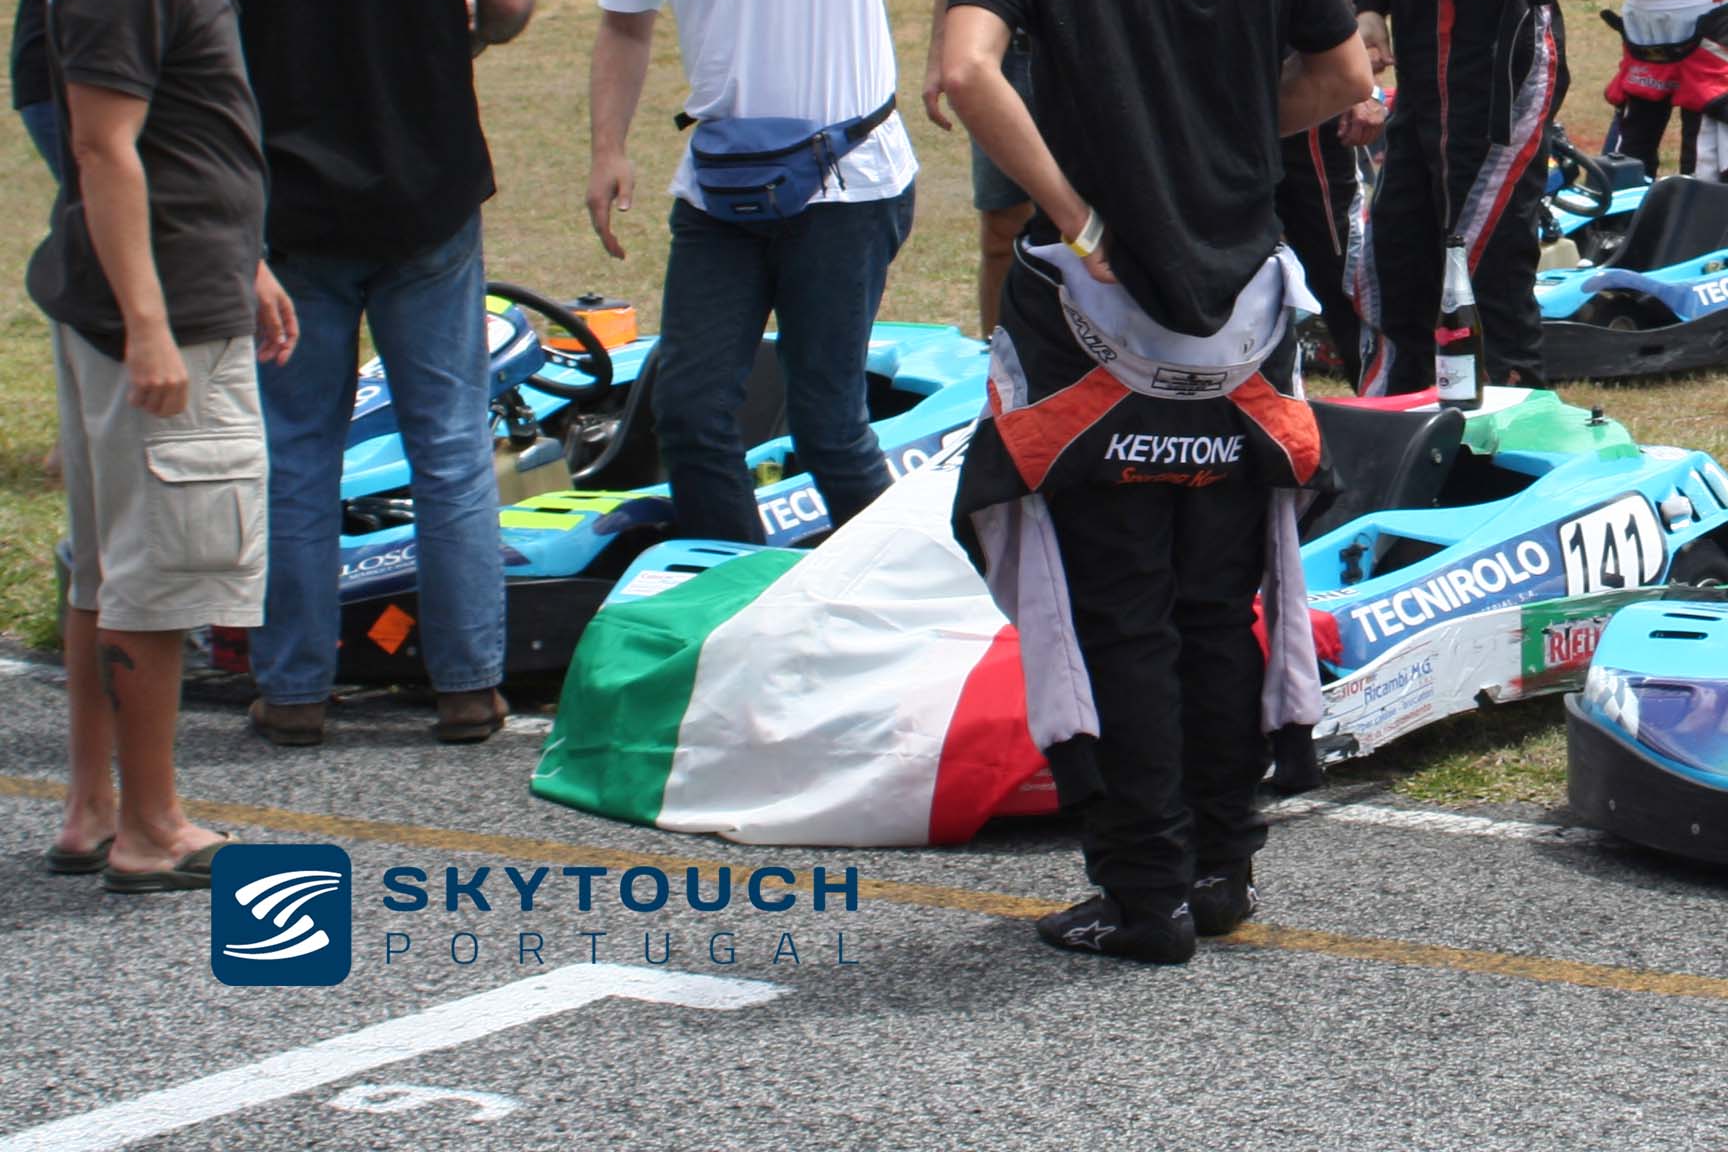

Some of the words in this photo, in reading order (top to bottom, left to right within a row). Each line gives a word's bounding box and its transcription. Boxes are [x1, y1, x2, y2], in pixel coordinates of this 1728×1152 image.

[1103, 432, 1247, 465] KEYSTONE
[1351, 539, 1550, 643] TECNIROLO
[1569, 513, 1645, 594] 141
